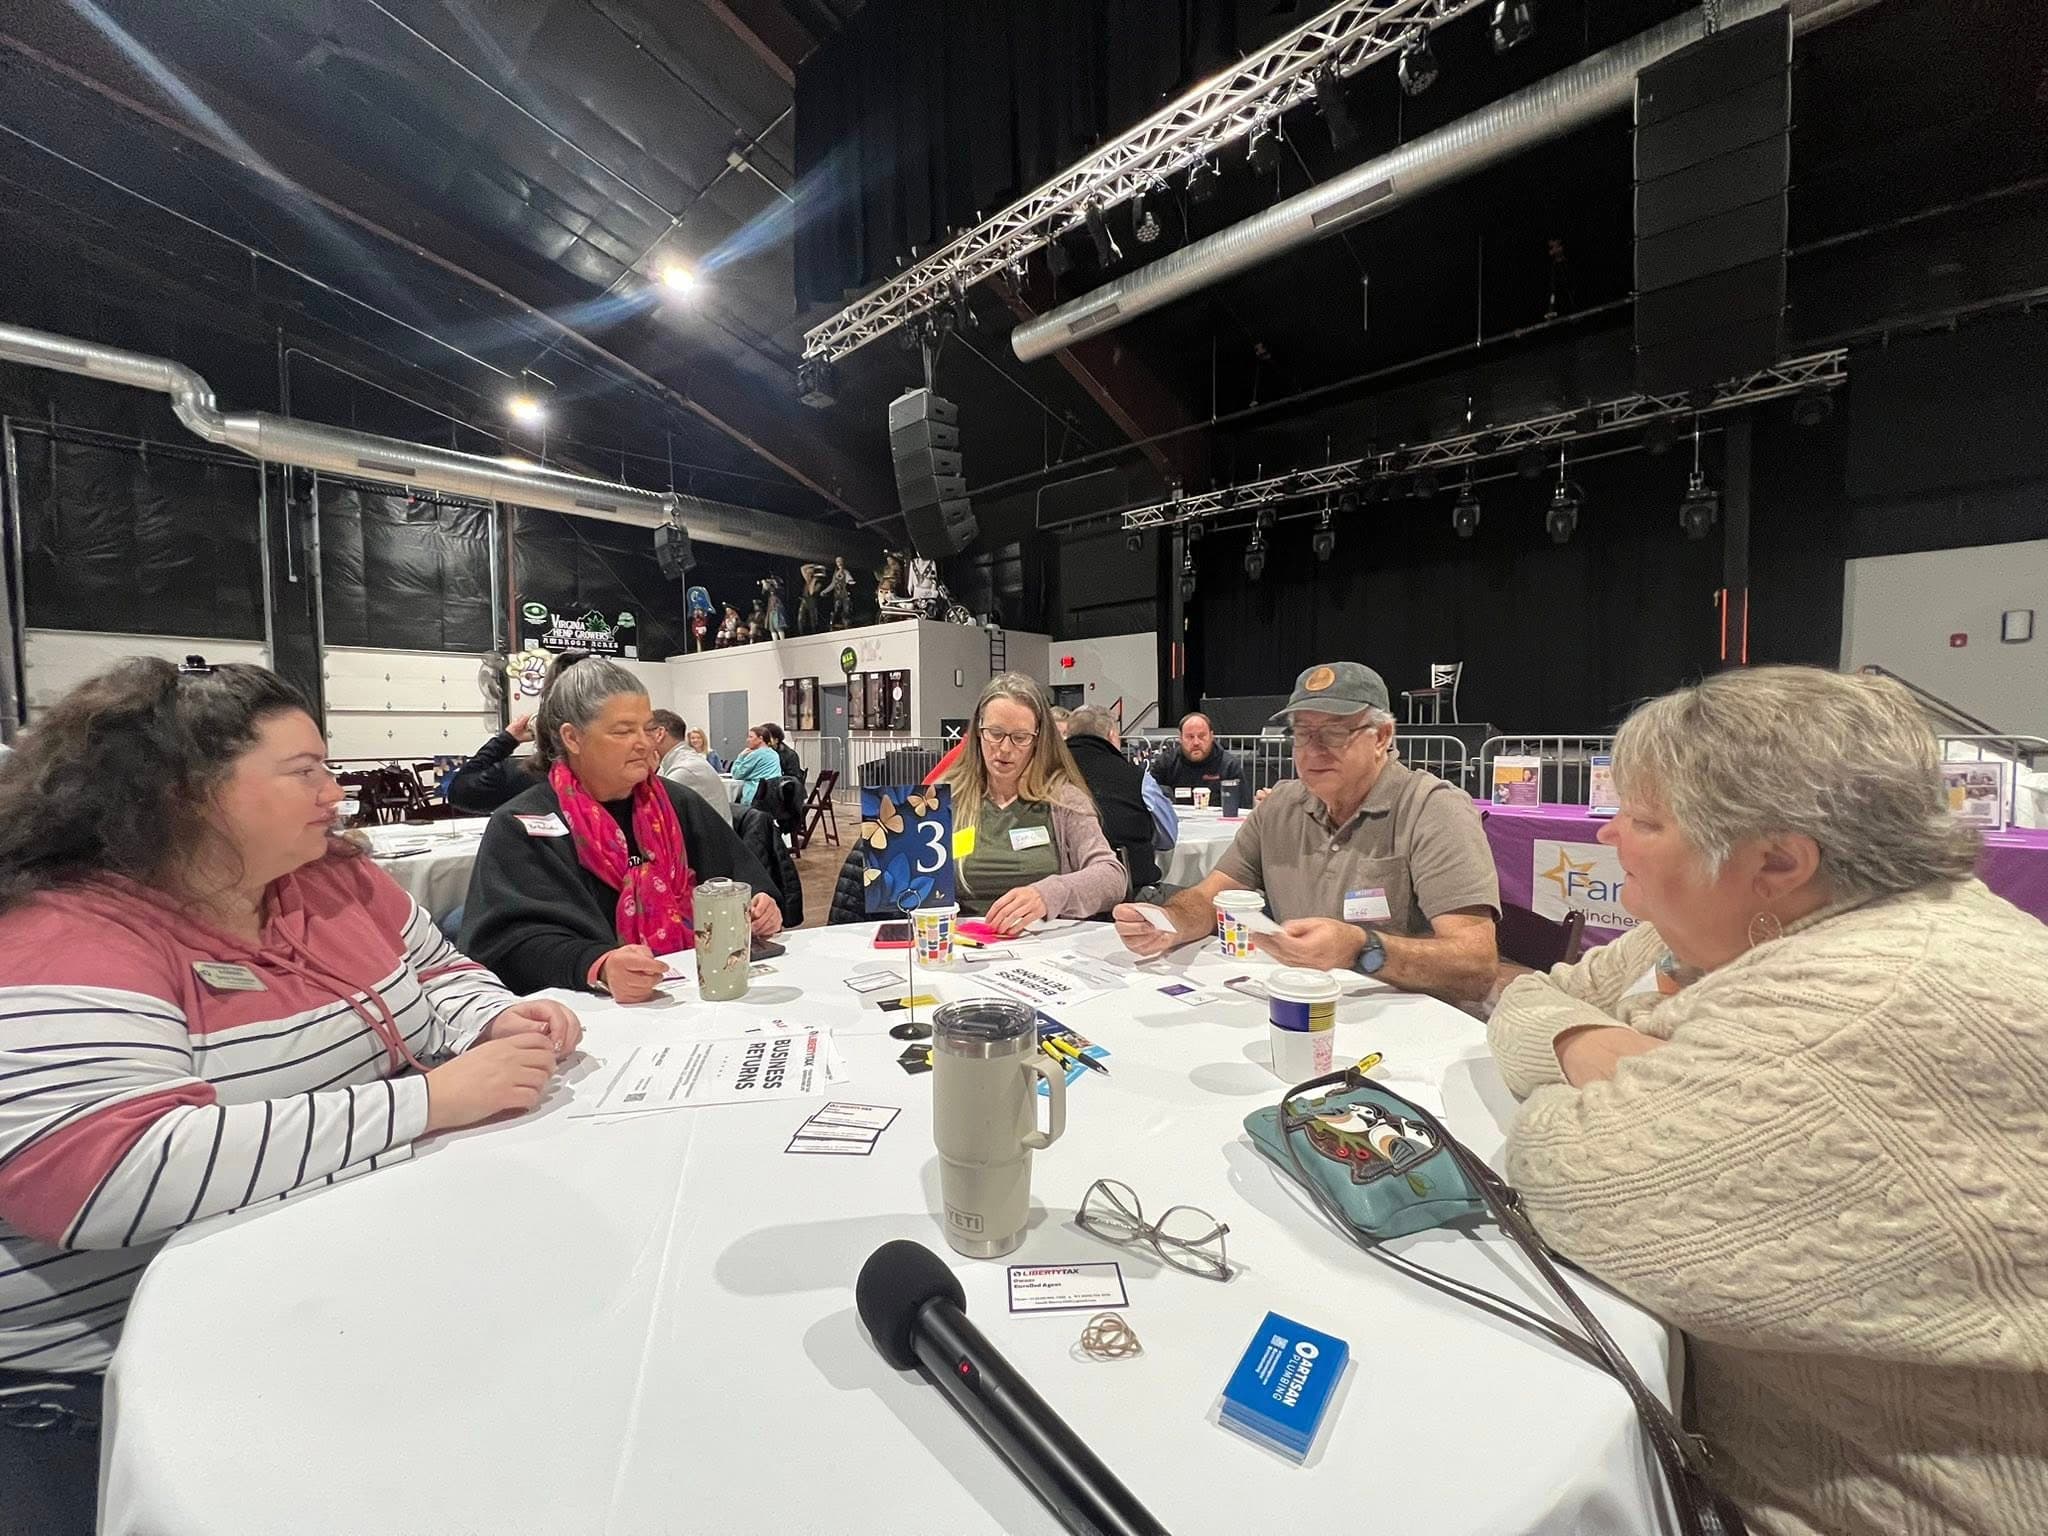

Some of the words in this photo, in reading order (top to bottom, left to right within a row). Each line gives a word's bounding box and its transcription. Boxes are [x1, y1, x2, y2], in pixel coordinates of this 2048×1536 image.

[553, 628, 573, 638] HEMP
[574, 630, 609, 640] GROWERS
[916, 820, 947, 873] 3
[735, 1042, 767, 1090] RETURNS
[763, 1038, 792, 1089] BUSINESS
[946, 1207, 979, 1230] YETI
[1272, 1354, 1303, 1401] PLUMBING
[1282, 1358, 1314, 1408] ARTISAN
